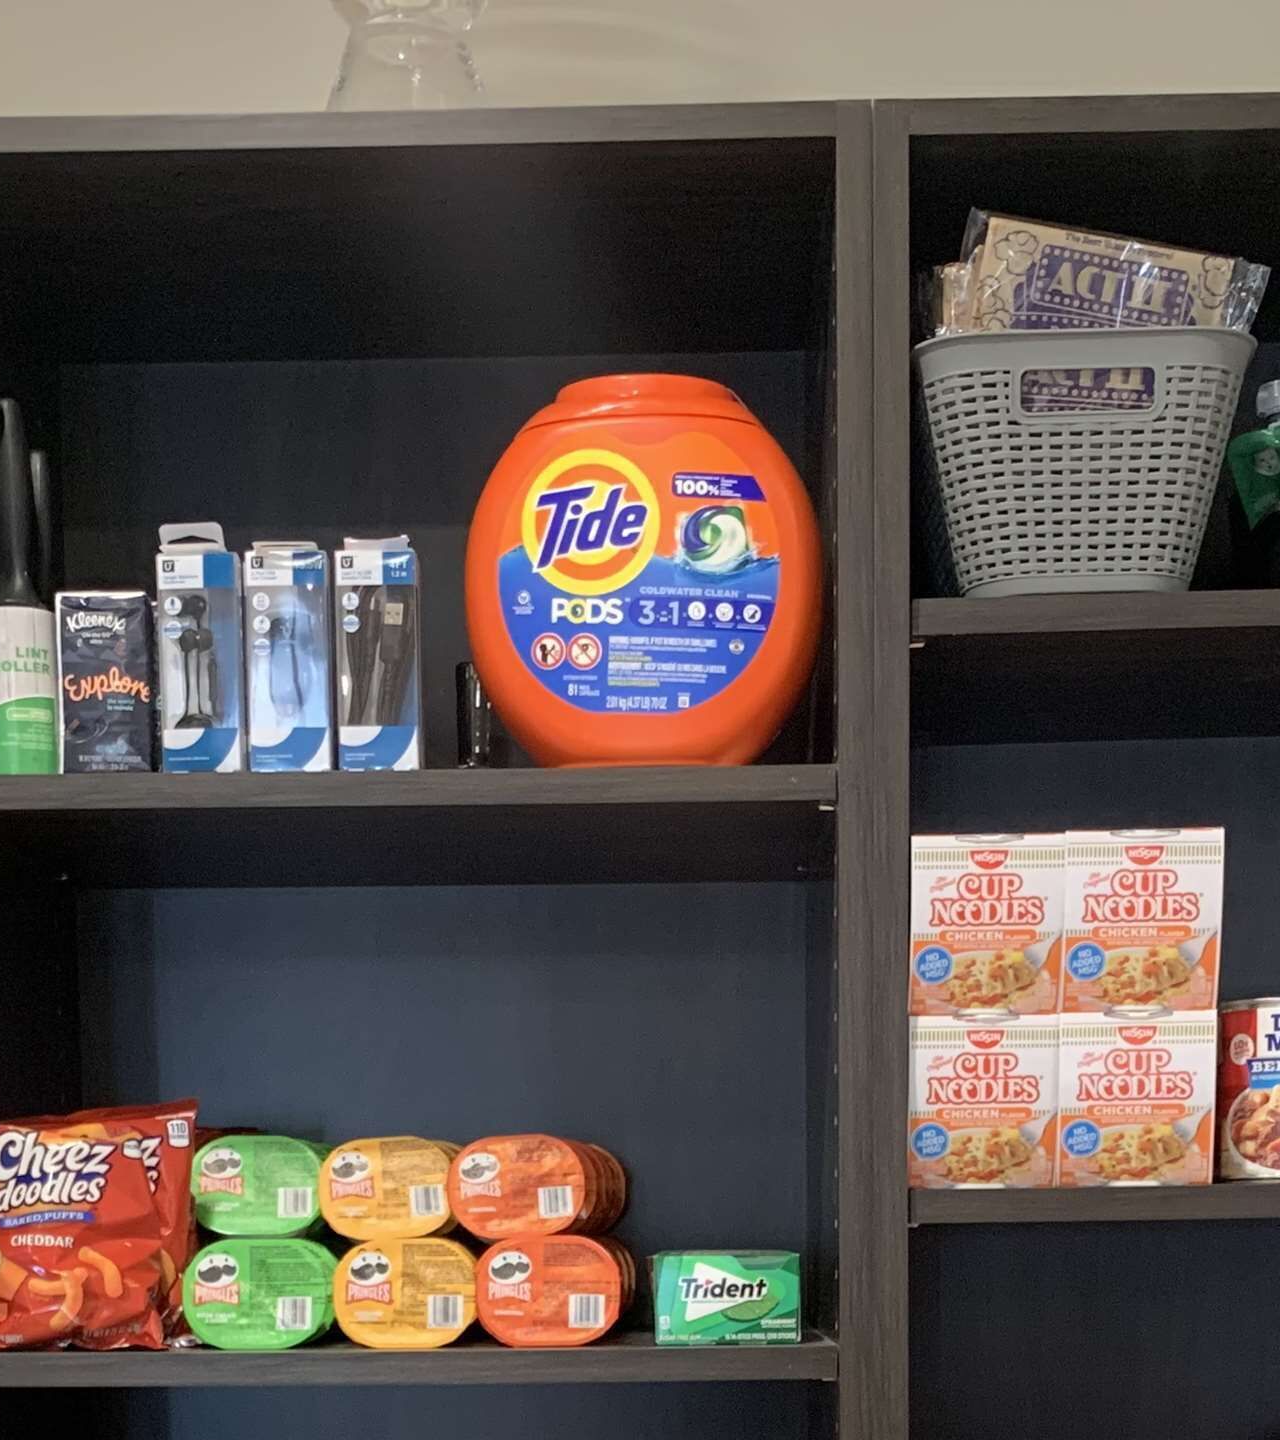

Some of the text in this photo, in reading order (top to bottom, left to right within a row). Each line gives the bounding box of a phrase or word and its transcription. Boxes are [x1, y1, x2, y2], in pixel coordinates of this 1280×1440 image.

[1048, 262, 1128, 303] ACT
[674, 478, 720, 497] 100%
[535, 485, 648, 571] Tide
[639, 585, 739, 599] COLDWATER CLEAN
[66, 612, 126, 633] Kleenex
[551, 598, 624, 625] PODS
[15, 647, 50, 661] LINT
[64, 666, 151, 703] Explore
[956, 872, 1023, 900] CUP
[1111, 869, 1178, 896] CUP
[930, 897, 1044, 928] NOODLES
[1083, 893, 1200, 924] NOODLES
[946, 930, 1004, 941] CHICKEN
[1098, 926, 1158, 938] CHICKEN
[953, 1052, 1018, 1079] CUP
[926, 1075, 1040, 1105] NOODLES
[942, 1109, 1000, 1120] CHICKEN
[4, 1210, 85, 1228] BAKED PUFFS
[10, 1234, 74, 1249] CHEDDAR
[680, 1277, 768, 1300] Trident
